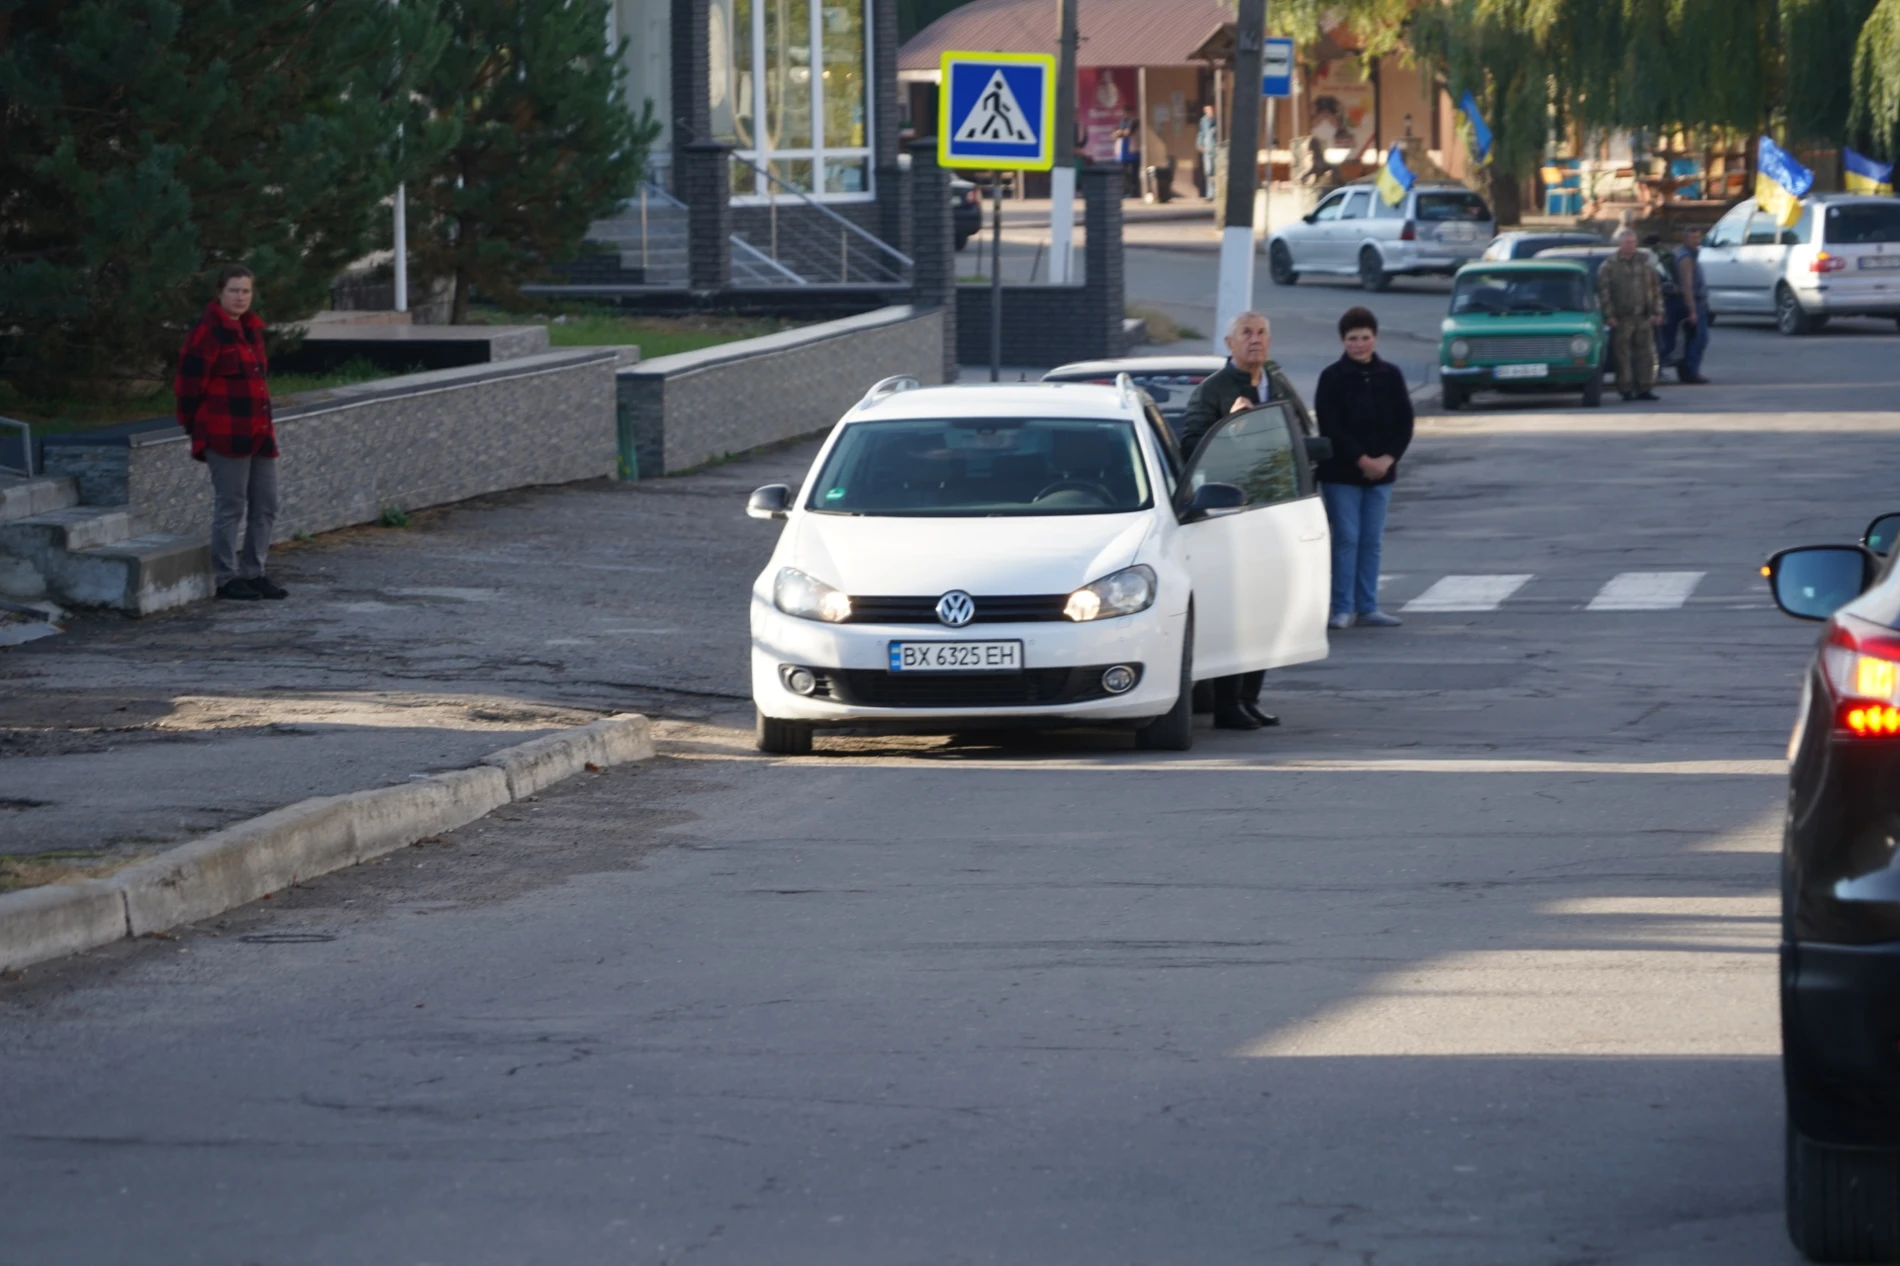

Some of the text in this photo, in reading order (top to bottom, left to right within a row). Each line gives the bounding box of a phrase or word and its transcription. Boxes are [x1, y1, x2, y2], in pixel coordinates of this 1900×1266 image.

[937, 591, 974, 626] VW
[903, 645, 1015, 666] BX 6325 EH
